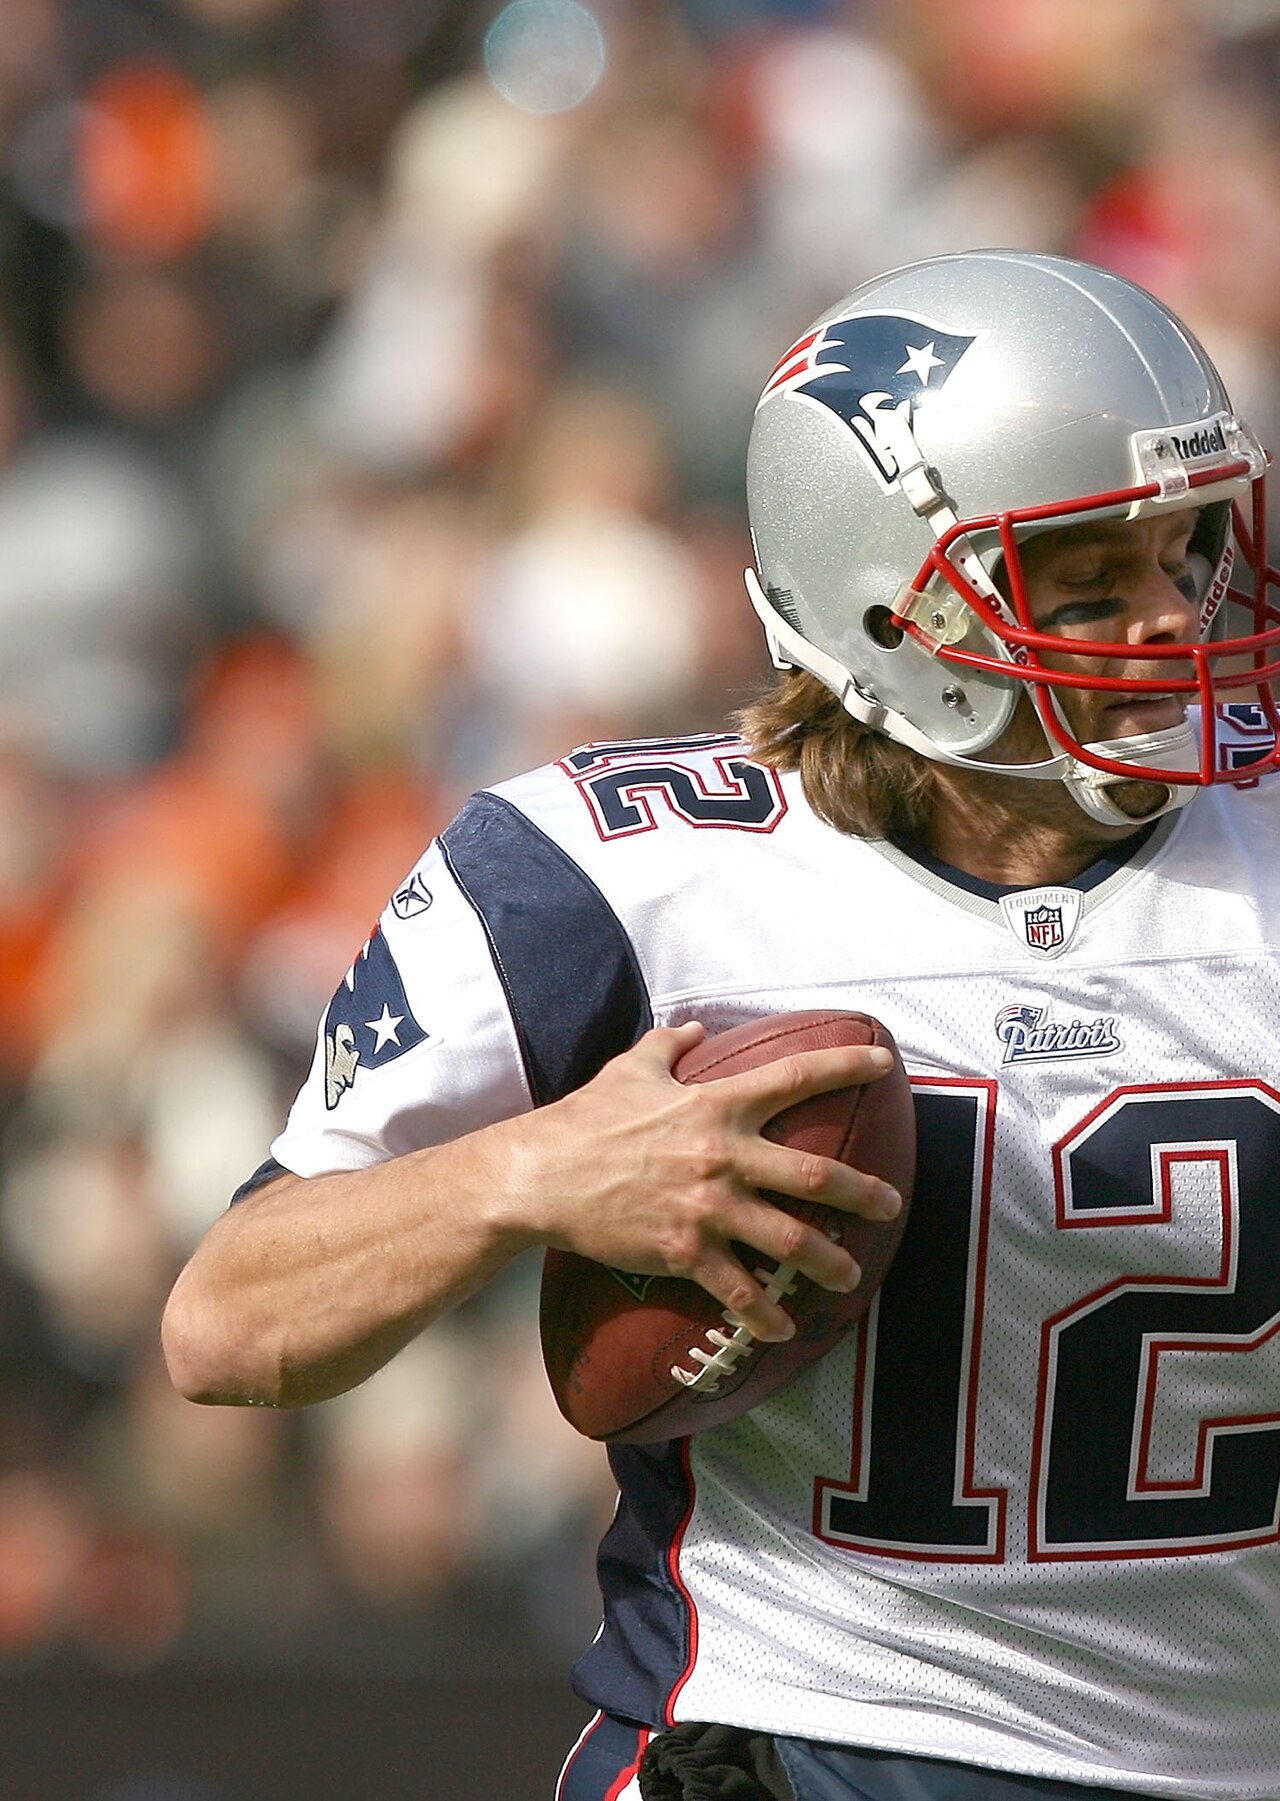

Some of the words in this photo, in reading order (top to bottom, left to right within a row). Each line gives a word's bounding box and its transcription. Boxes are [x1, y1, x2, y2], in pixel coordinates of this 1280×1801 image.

[1199, 546, 1233, 636] iddell
[553, 731, 788, 842] 12
[1009, 892, 1076, 910] EQUIPMENT
[1029, 922, 1061, 945] NFL
[996, 1008, 1122, 1065] Patriots
